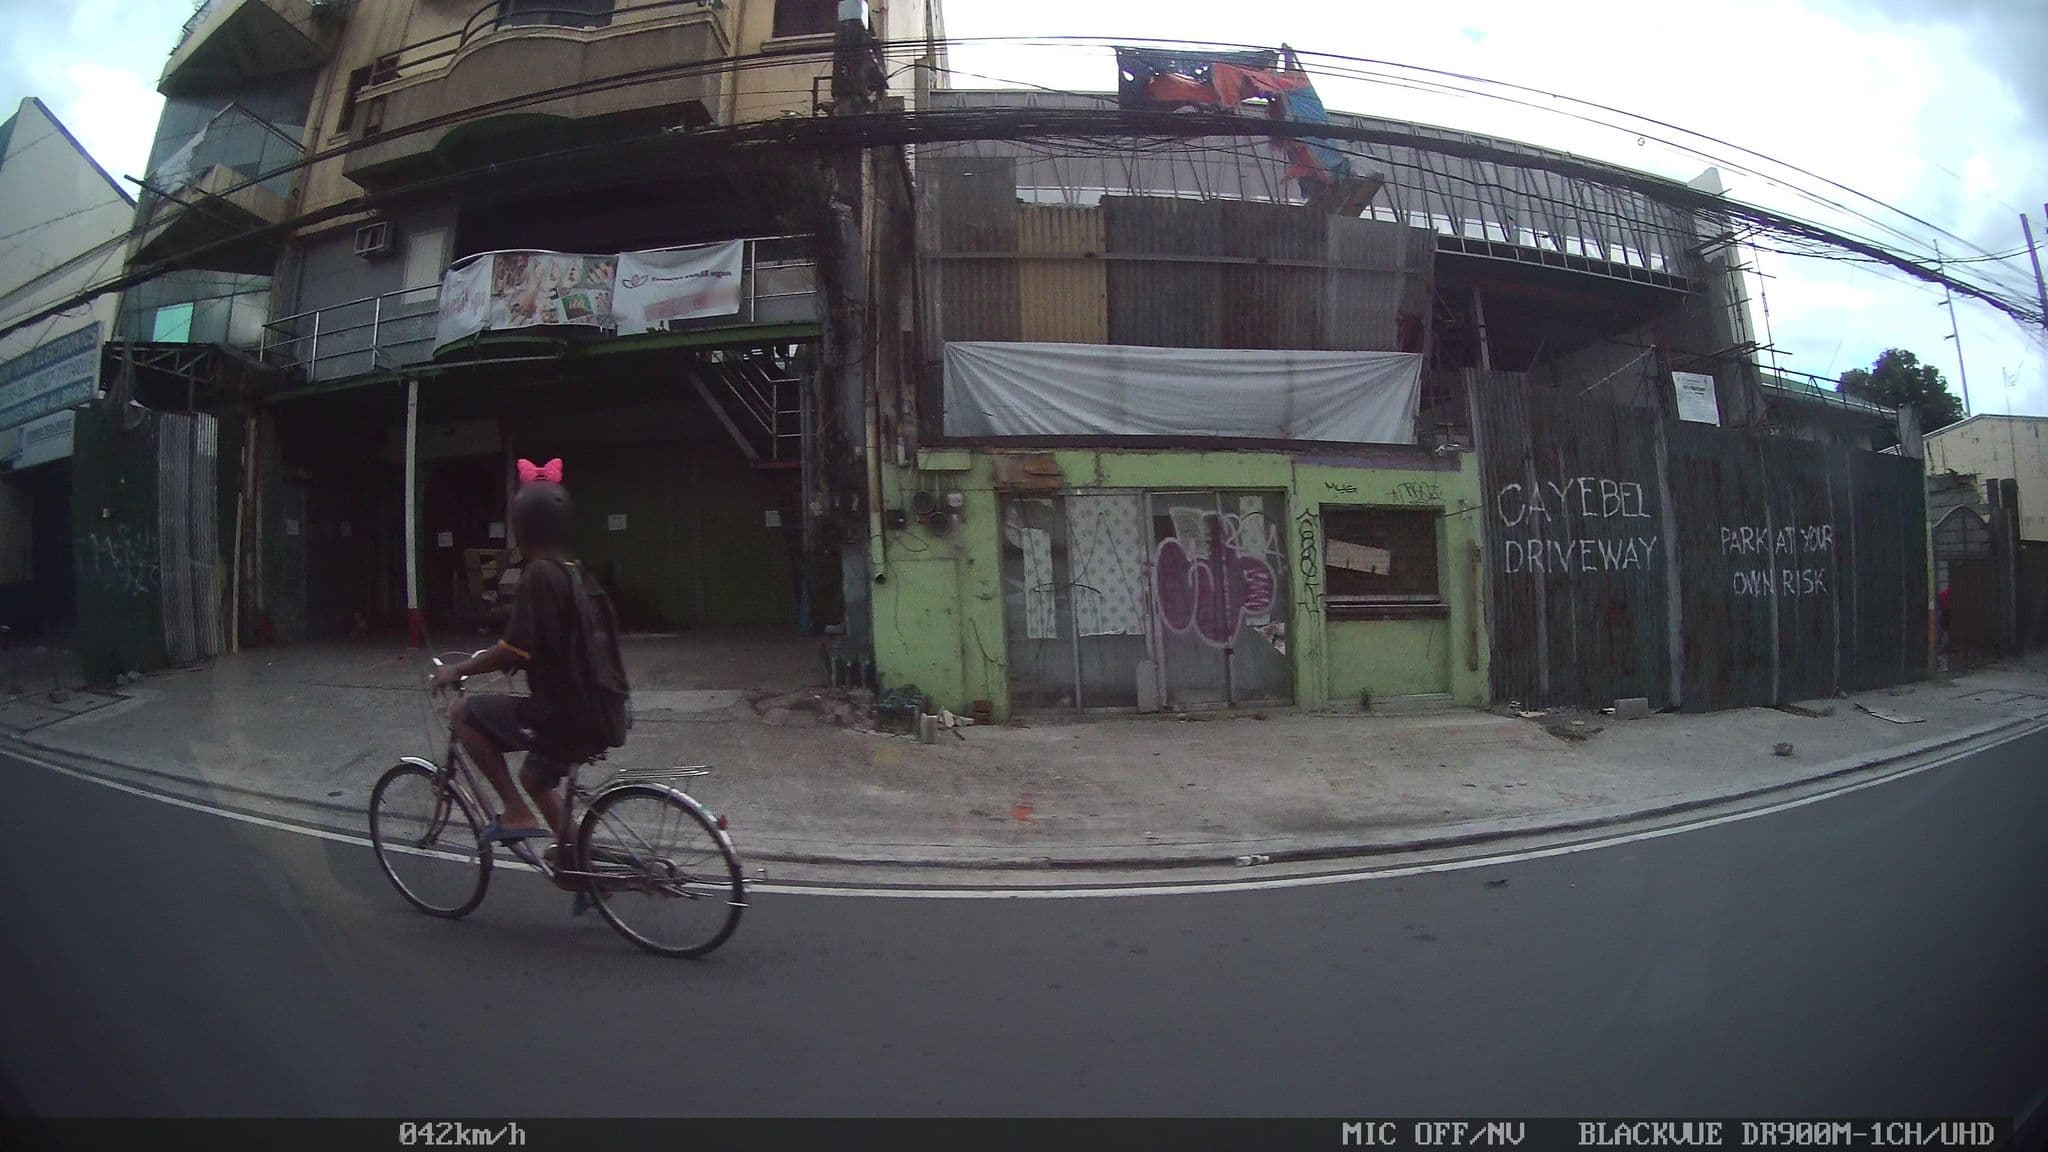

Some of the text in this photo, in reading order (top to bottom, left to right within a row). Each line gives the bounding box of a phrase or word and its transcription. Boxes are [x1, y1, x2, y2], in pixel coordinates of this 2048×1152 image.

[1497, 477, 1652, 527] CAYEBEL
[1504, 535, 1657, 574] DRIVEWAY
[1720, 524, 1833, 556] PARK AT YOUR
[1733, 568, 1827, 598] OWN RISK
